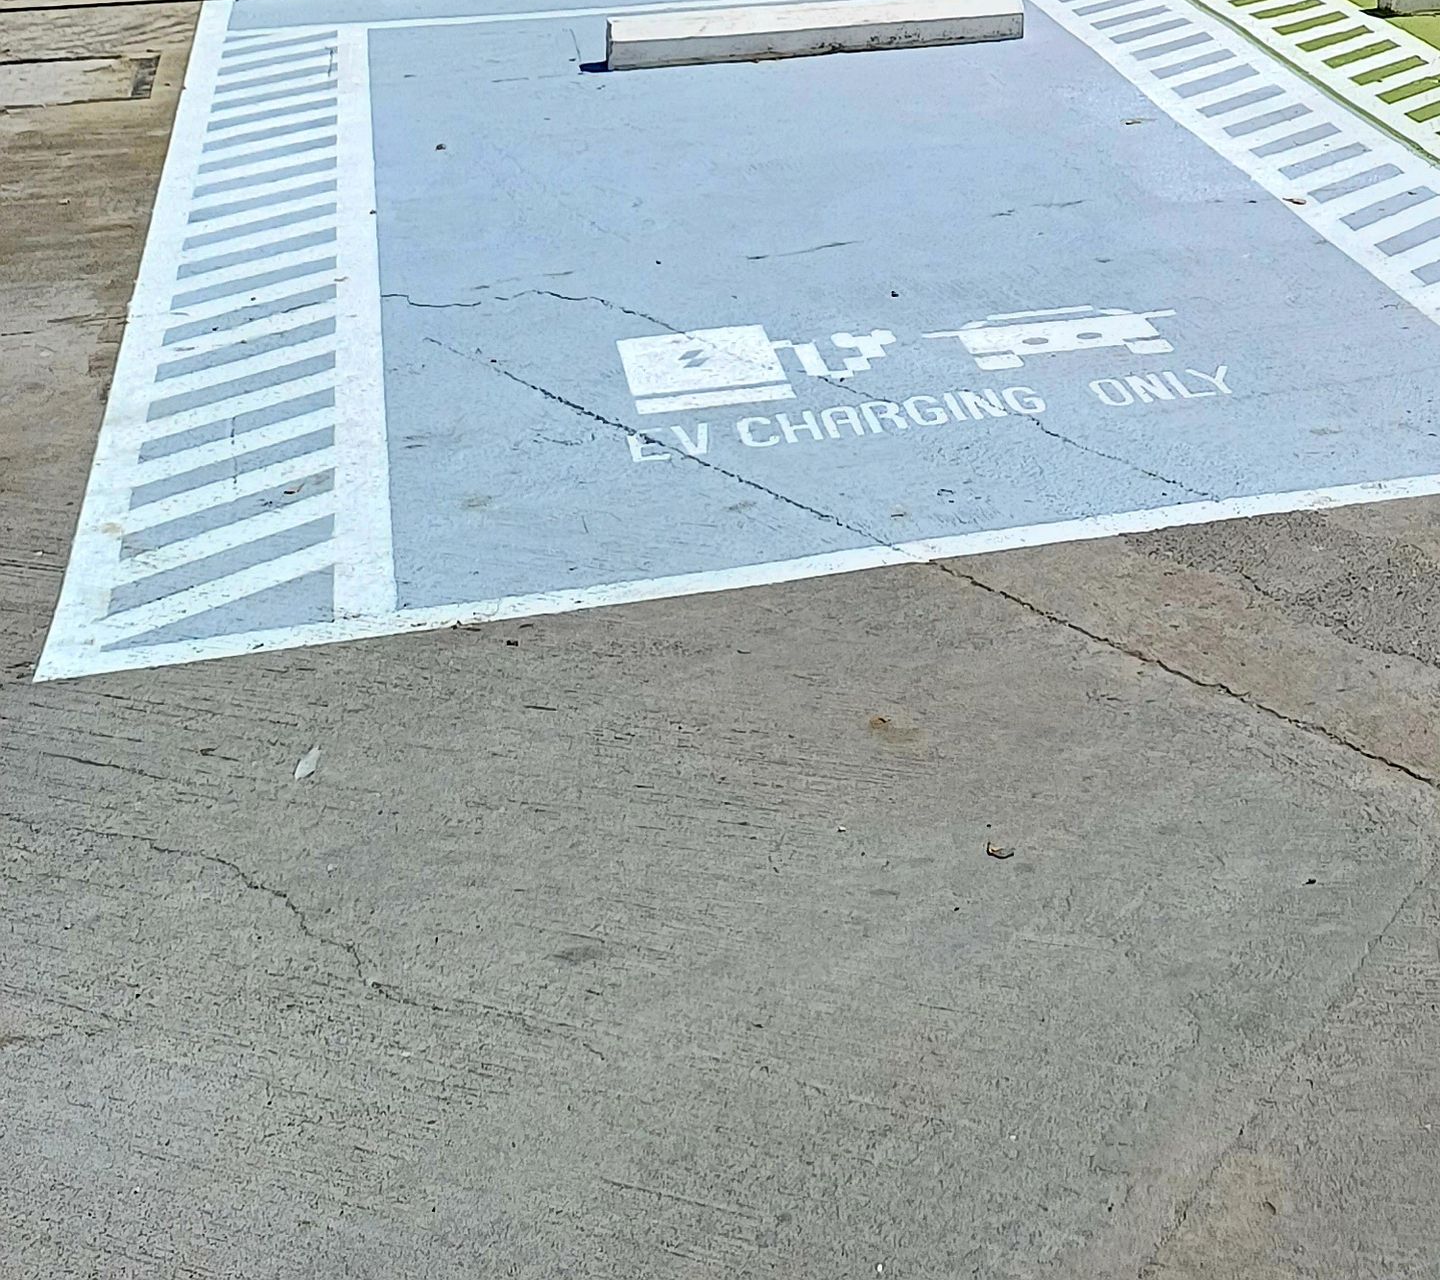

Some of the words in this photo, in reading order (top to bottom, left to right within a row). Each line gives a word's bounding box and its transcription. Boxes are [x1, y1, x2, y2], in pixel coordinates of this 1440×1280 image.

[626, 425, 710, 462] EV
[740, 386, 1047, 447] CHARGING
[1088, 365, 1234, 407] ONLY
